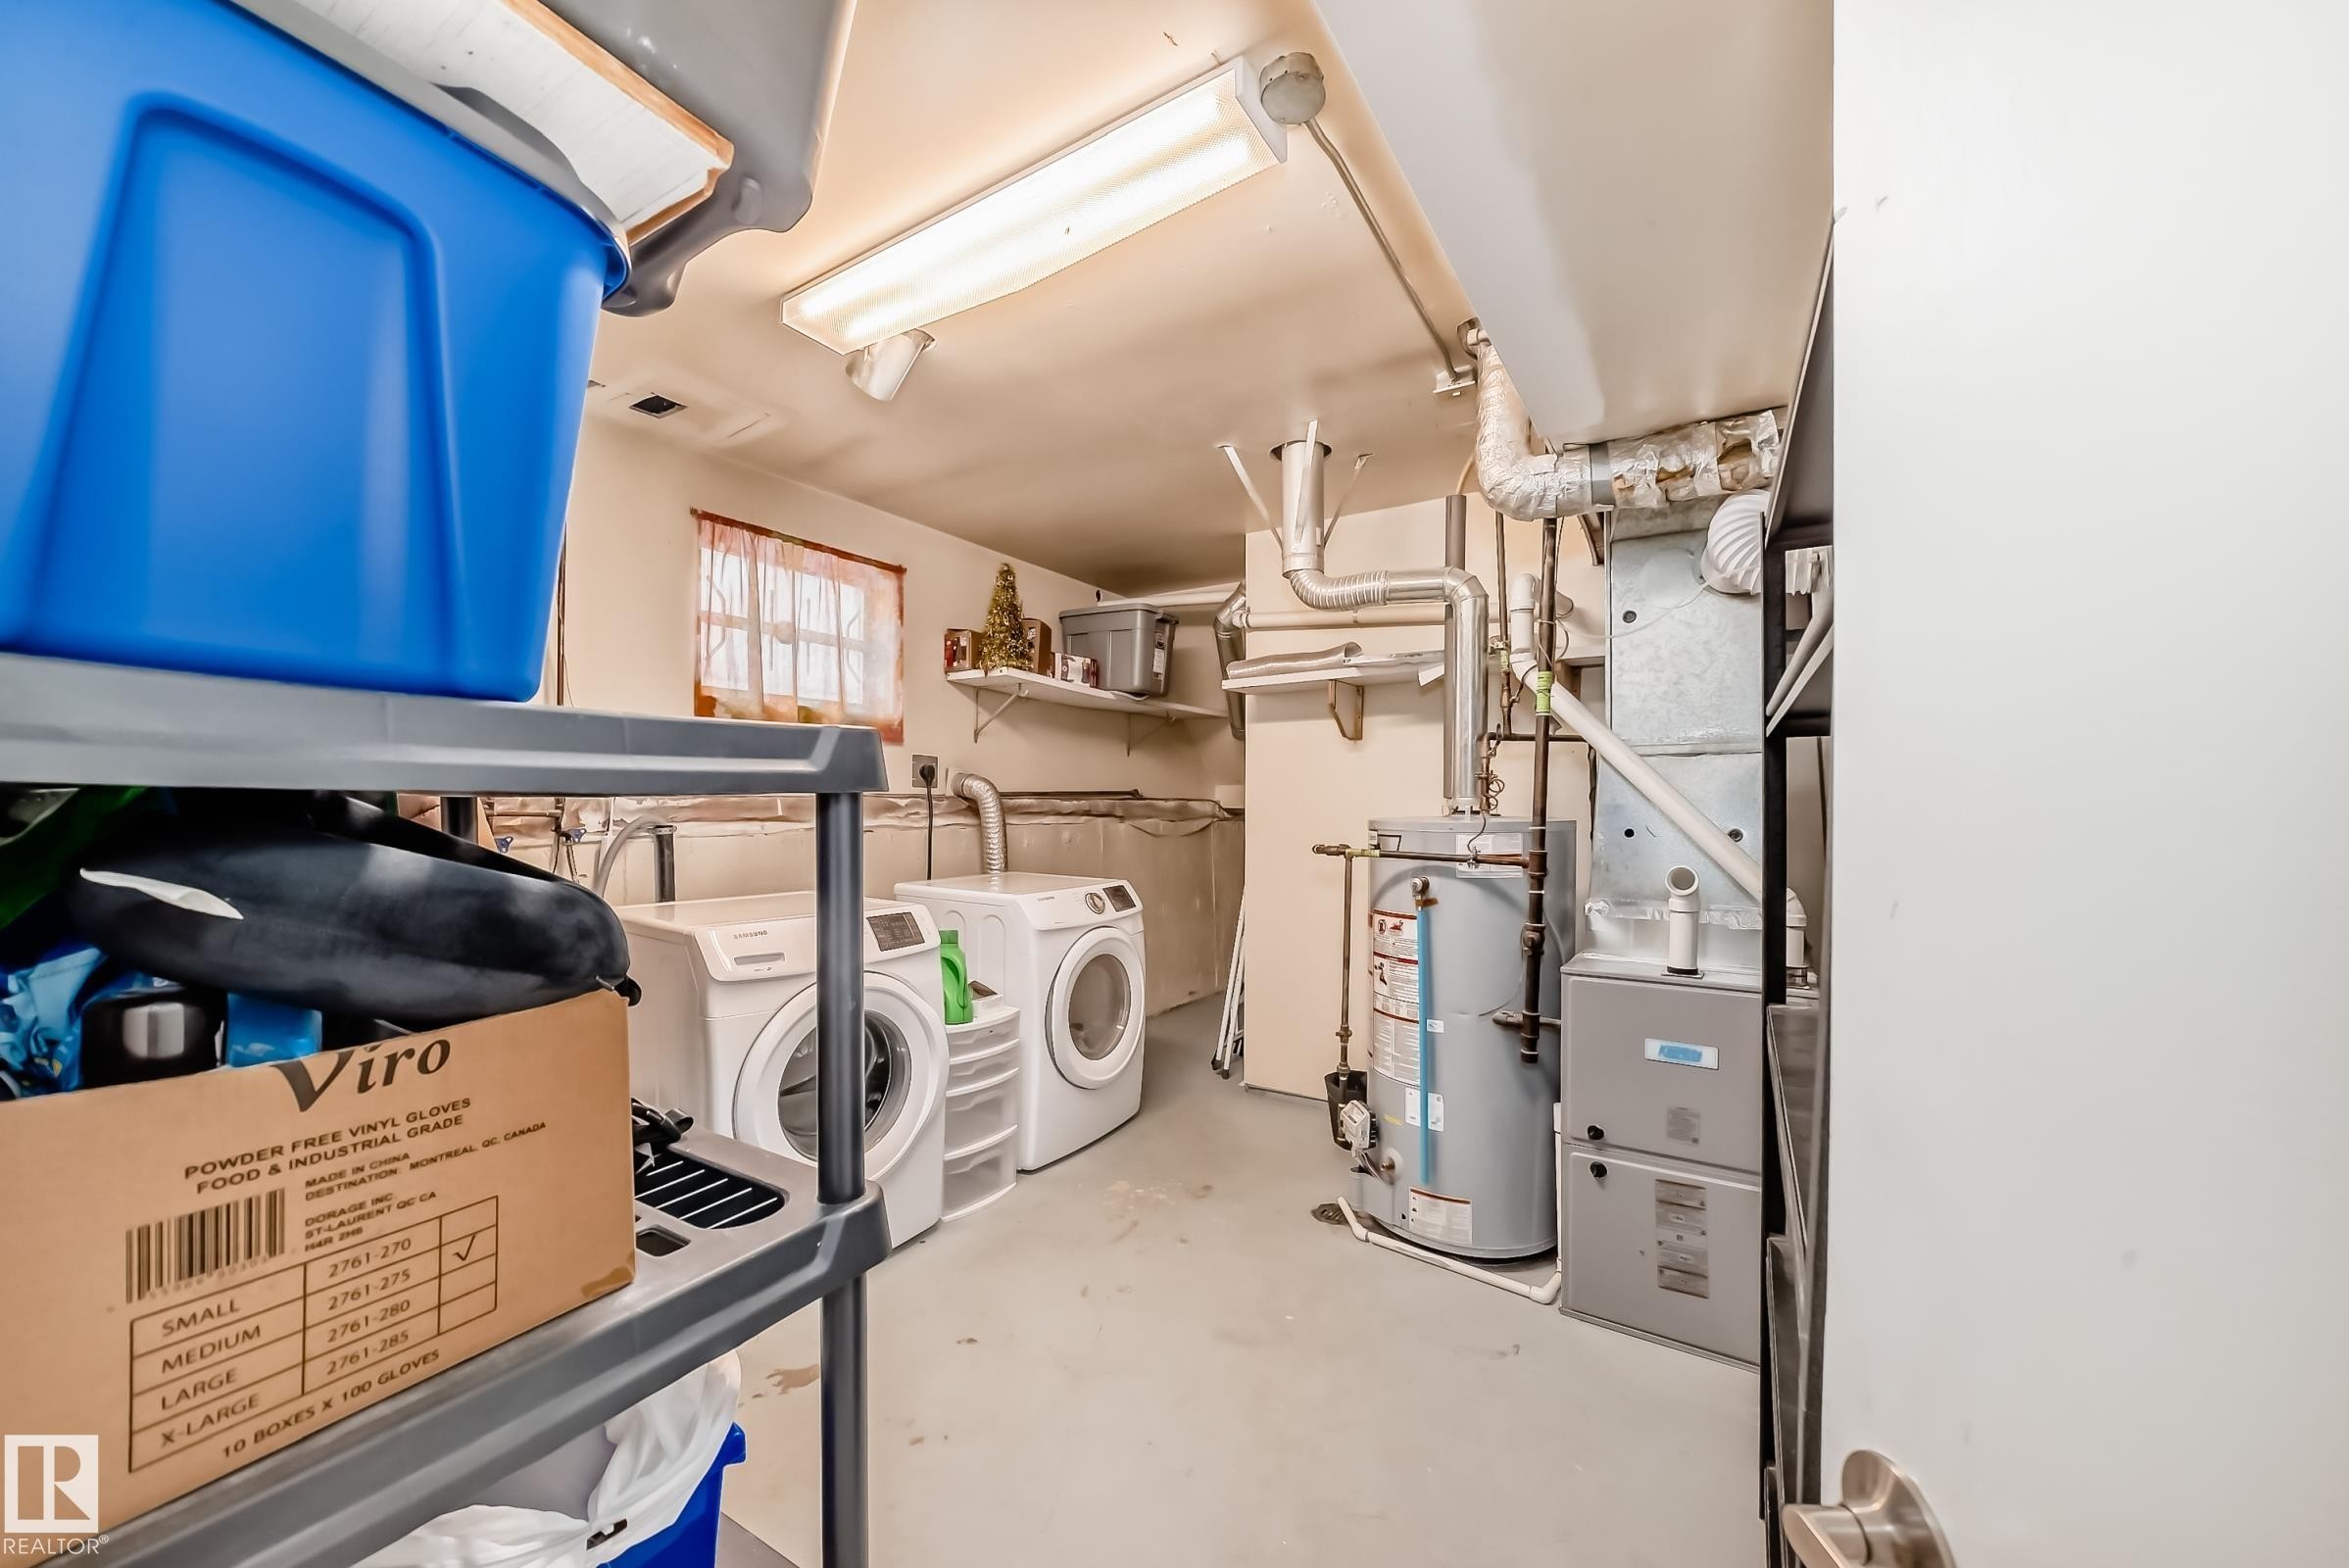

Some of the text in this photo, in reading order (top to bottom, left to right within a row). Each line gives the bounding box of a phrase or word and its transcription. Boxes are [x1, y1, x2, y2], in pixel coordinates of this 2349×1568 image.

[732, 929, 769, 940] SAMSUNG
[269, 1038, 452, 1112] Viro
[184, 1097, 471, 1180] POWDER FREE VINYL GLOVES
[196, 1113, 465, 1195] FOOD & INDUSTRIAL GRADE
[305, 1152, 411, 1189] MADE IN CHINA
[503, 1122, 547, 1142] CANADA
[305, 1191, 437, 1240] ST-LAURENT QC CA
[161, 1267, 412, 1375] MEDIUM 2761-275
[162, 1237, 413, 1338] SMALL 2761-270
[160, 1298, 412, 1411] LARGE 2761-280
[160, 1329, 410, 1448] X-LARGE 2761-285
[222, 1348, 440, 1459] 10 BOXES X 100 GLOVES
